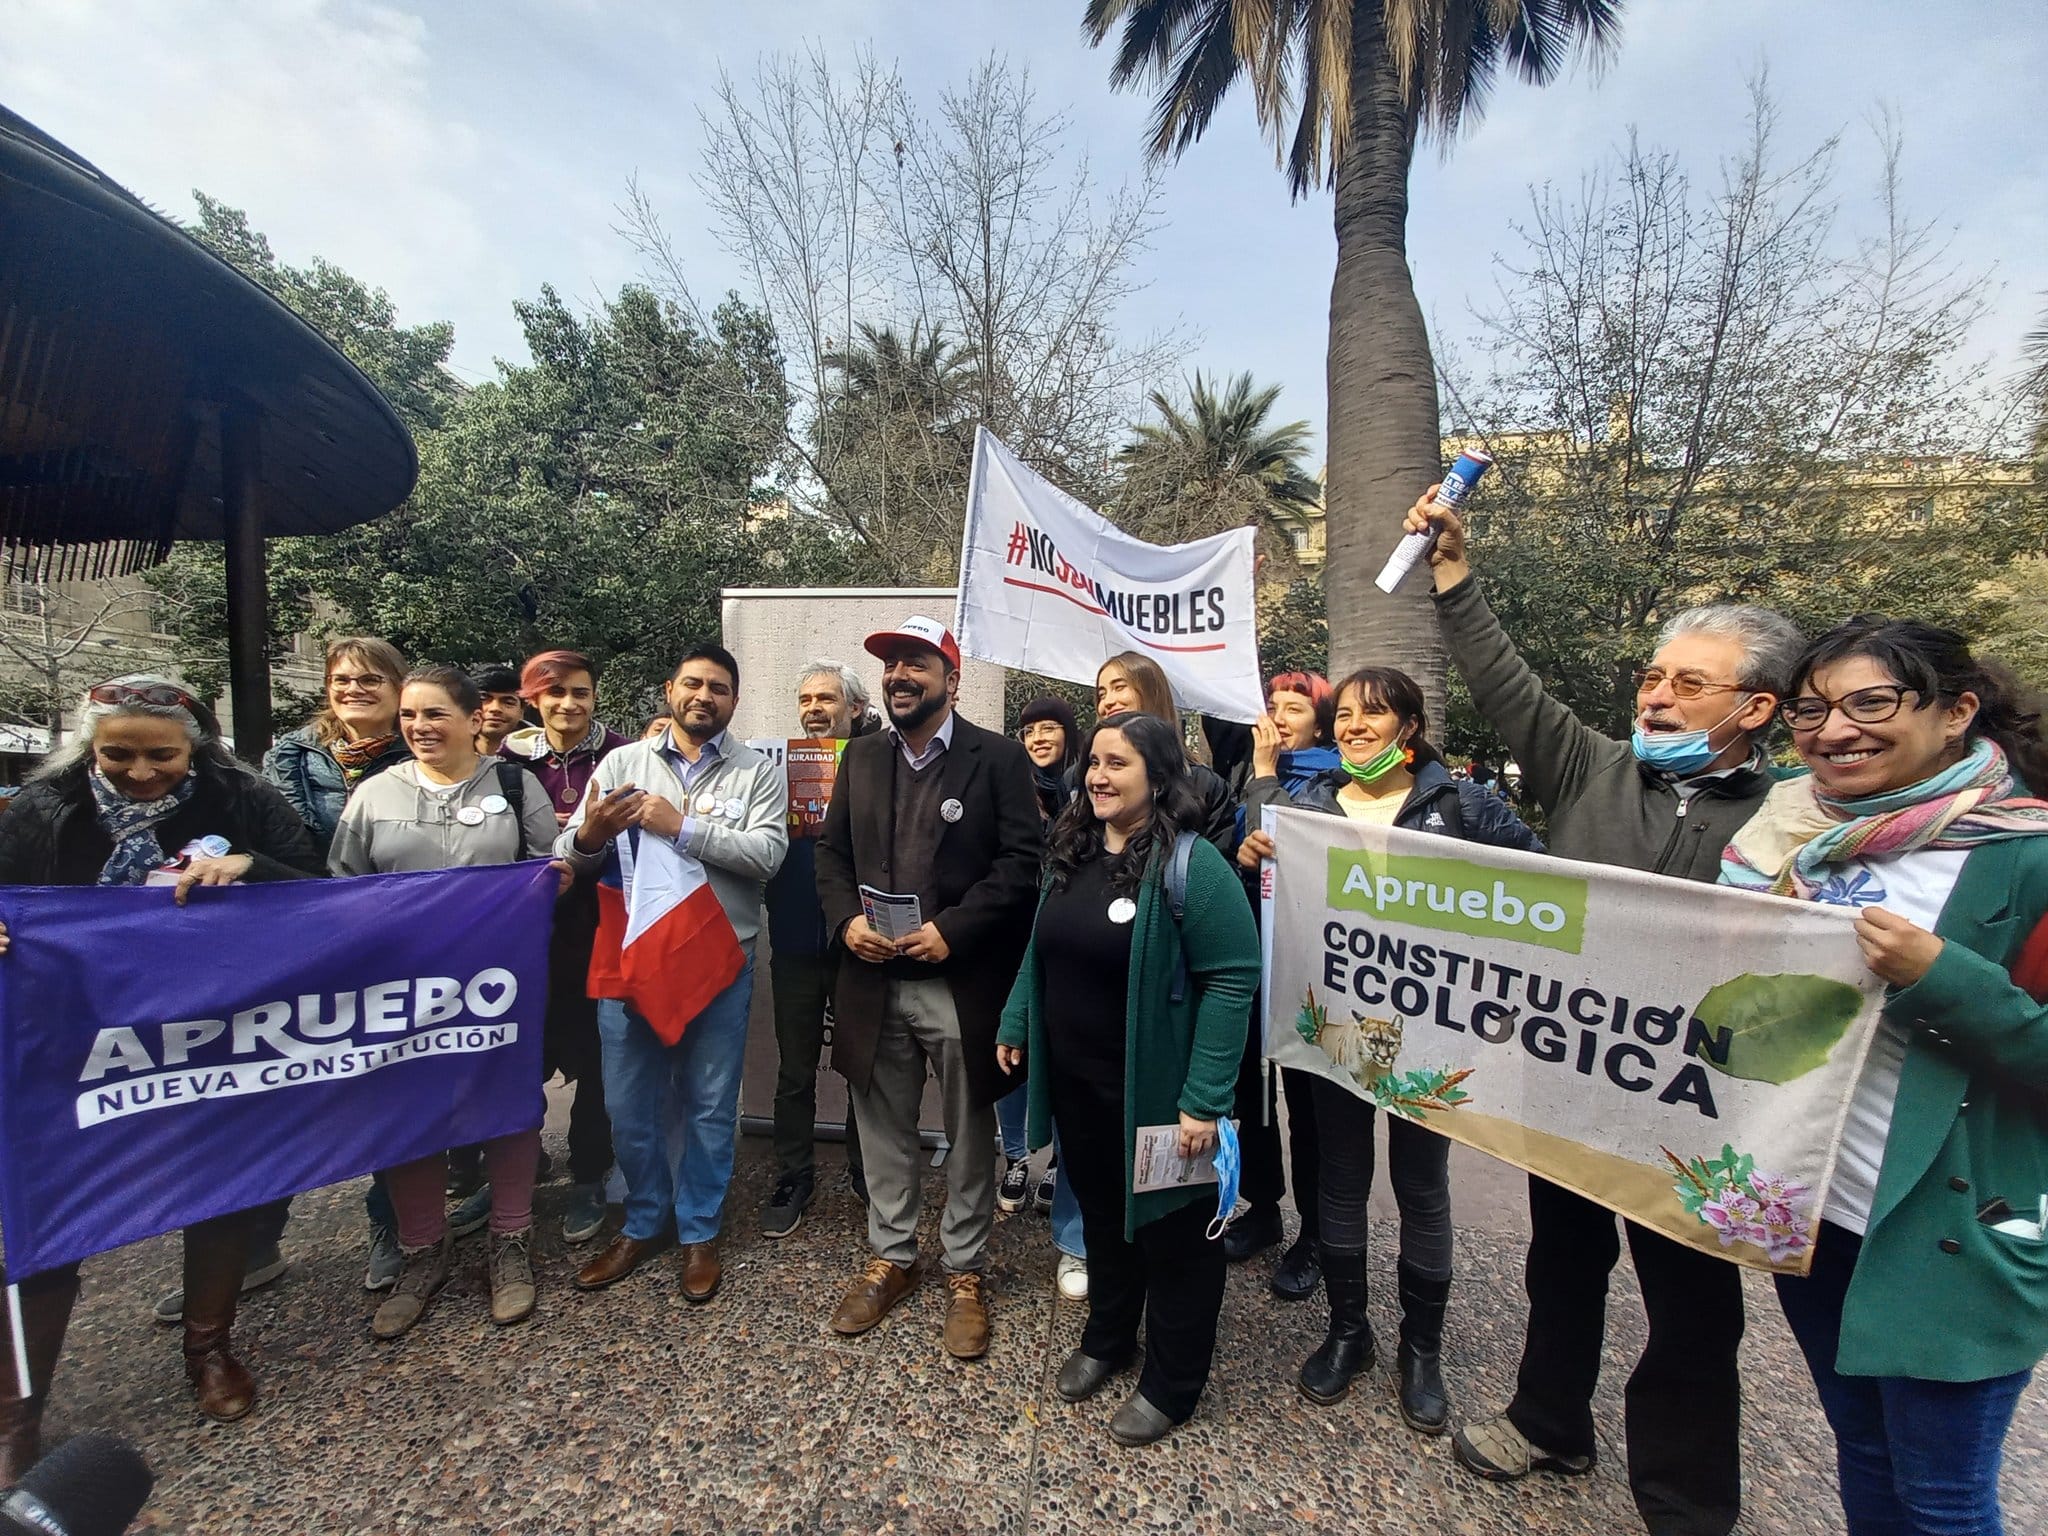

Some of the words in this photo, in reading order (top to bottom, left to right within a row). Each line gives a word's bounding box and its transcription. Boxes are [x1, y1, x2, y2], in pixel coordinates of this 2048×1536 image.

[788, 753, 834, 762] RURALIDAD
[1342, 864, 1566, 932] Apruebo
[78, 967, 518, 1082] APRUEBO
[1323, 921, 1733, 1065] CONSTITUCIÓN
[1323, 951, 1719, 1119] ECOLÓGICA
[97, 1072, 240, 1116] NUEVA
[261, 1027, 507, 1087] CONSTITUCIÓN
